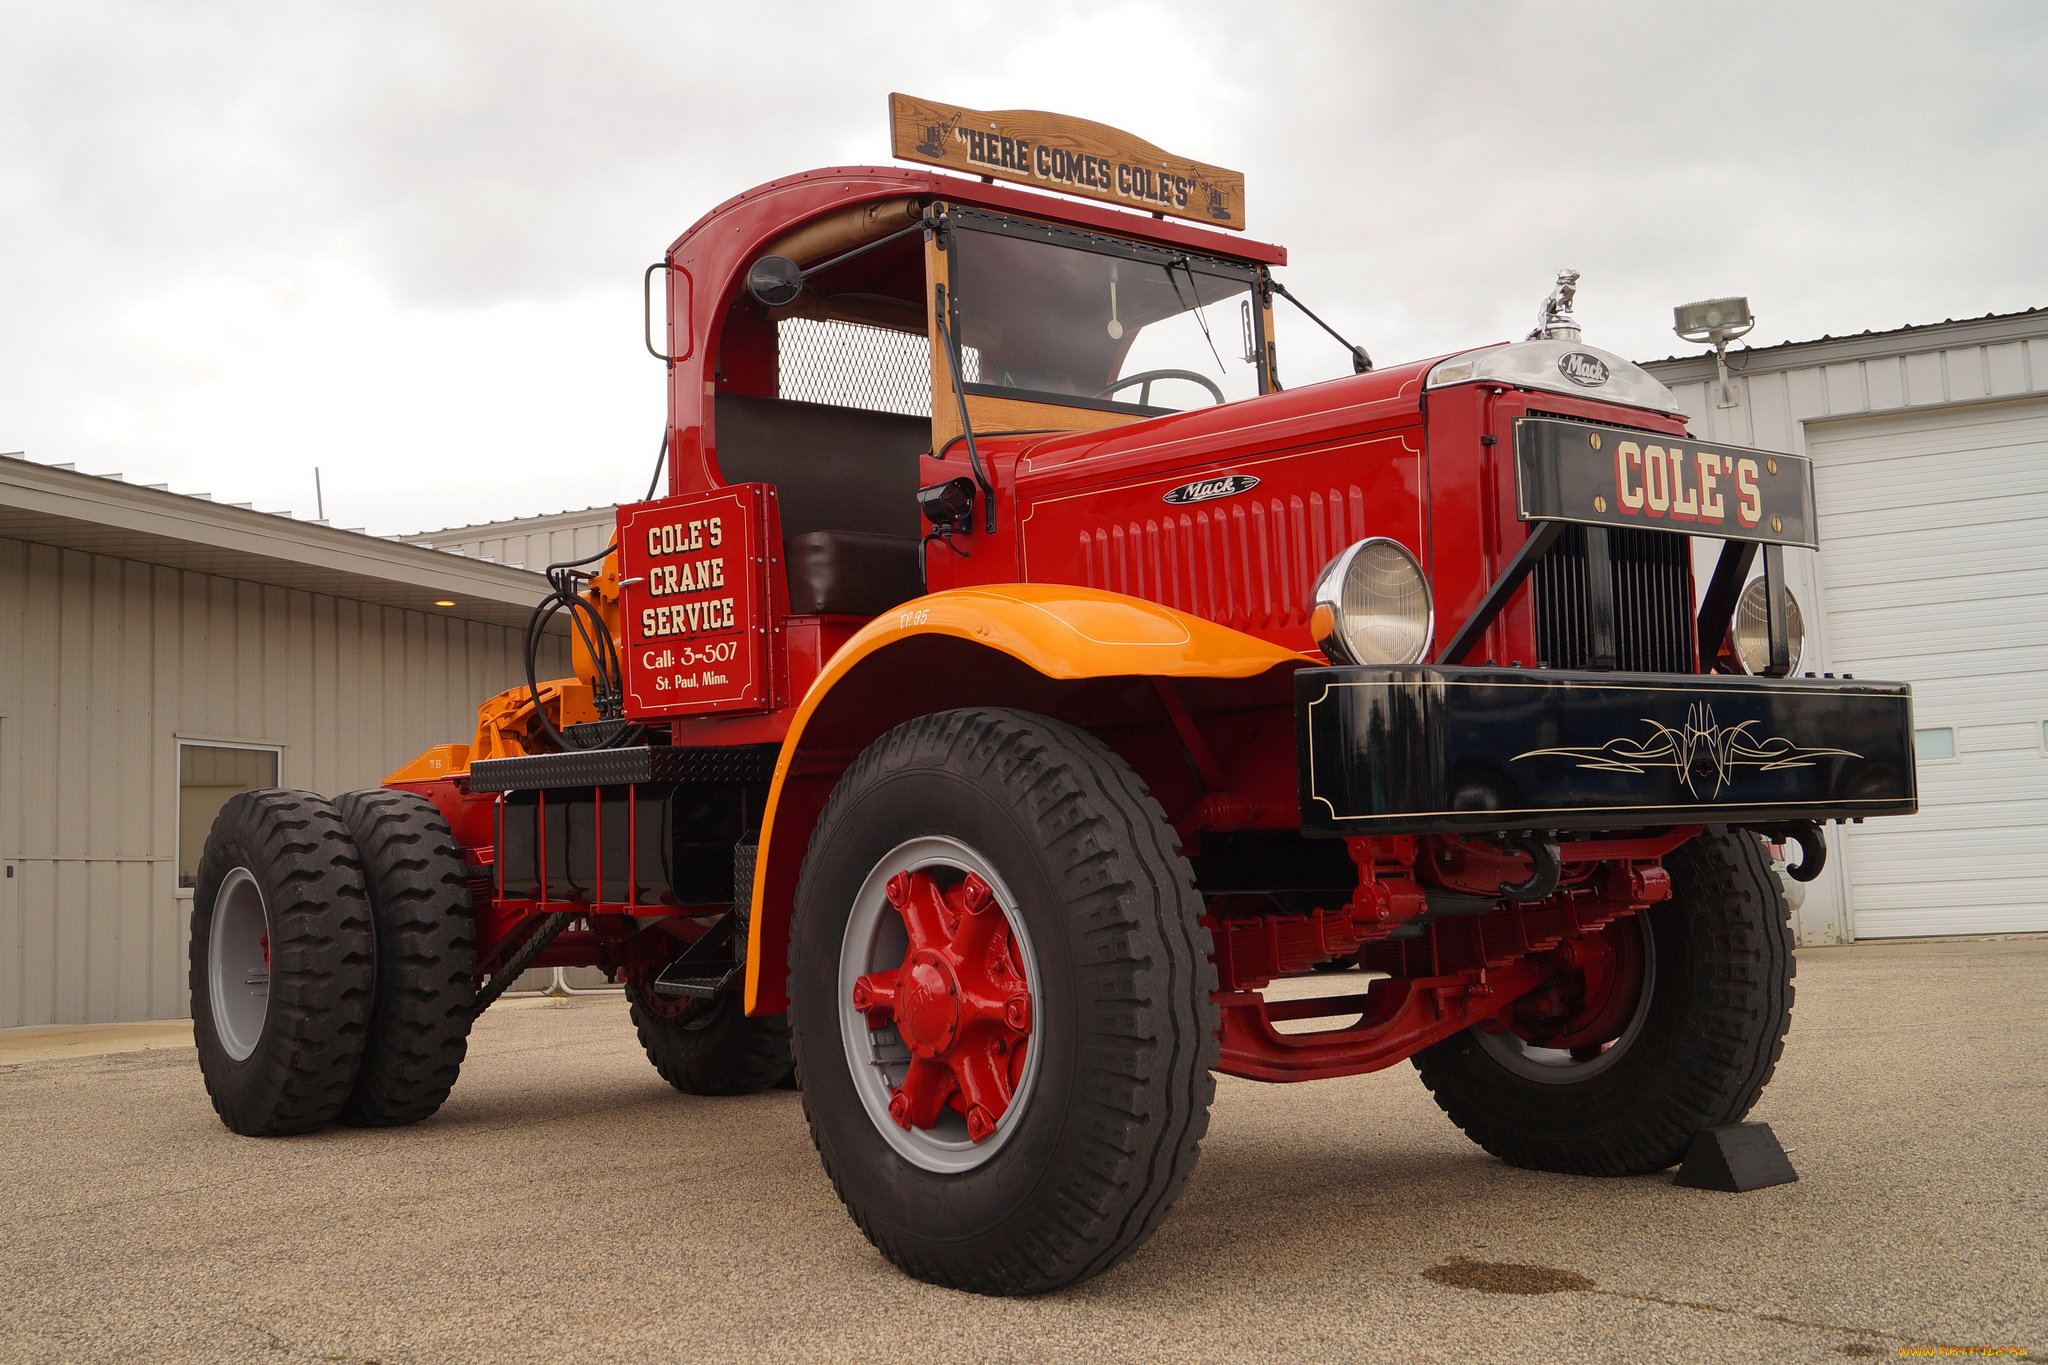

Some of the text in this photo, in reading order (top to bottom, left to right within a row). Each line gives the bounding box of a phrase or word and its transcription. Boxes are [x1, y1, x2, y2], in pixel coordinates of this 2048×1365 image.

[1034, 145, 1111, 193] COMES
[1566, 353, 1606, 382] Mack
[1183, 477, 1235, 500] Mack
[1614, 441, 1762, 528] COLE'S
[648, 517, 722, 557] COLE'S
[650, 558, 724, 598] CRANE
[641, 597, 735, 638] SERVICE
[642, 641, 737, 670] Call: 3-507
[655, 670, 729, 690] St. Paul, Minn.
